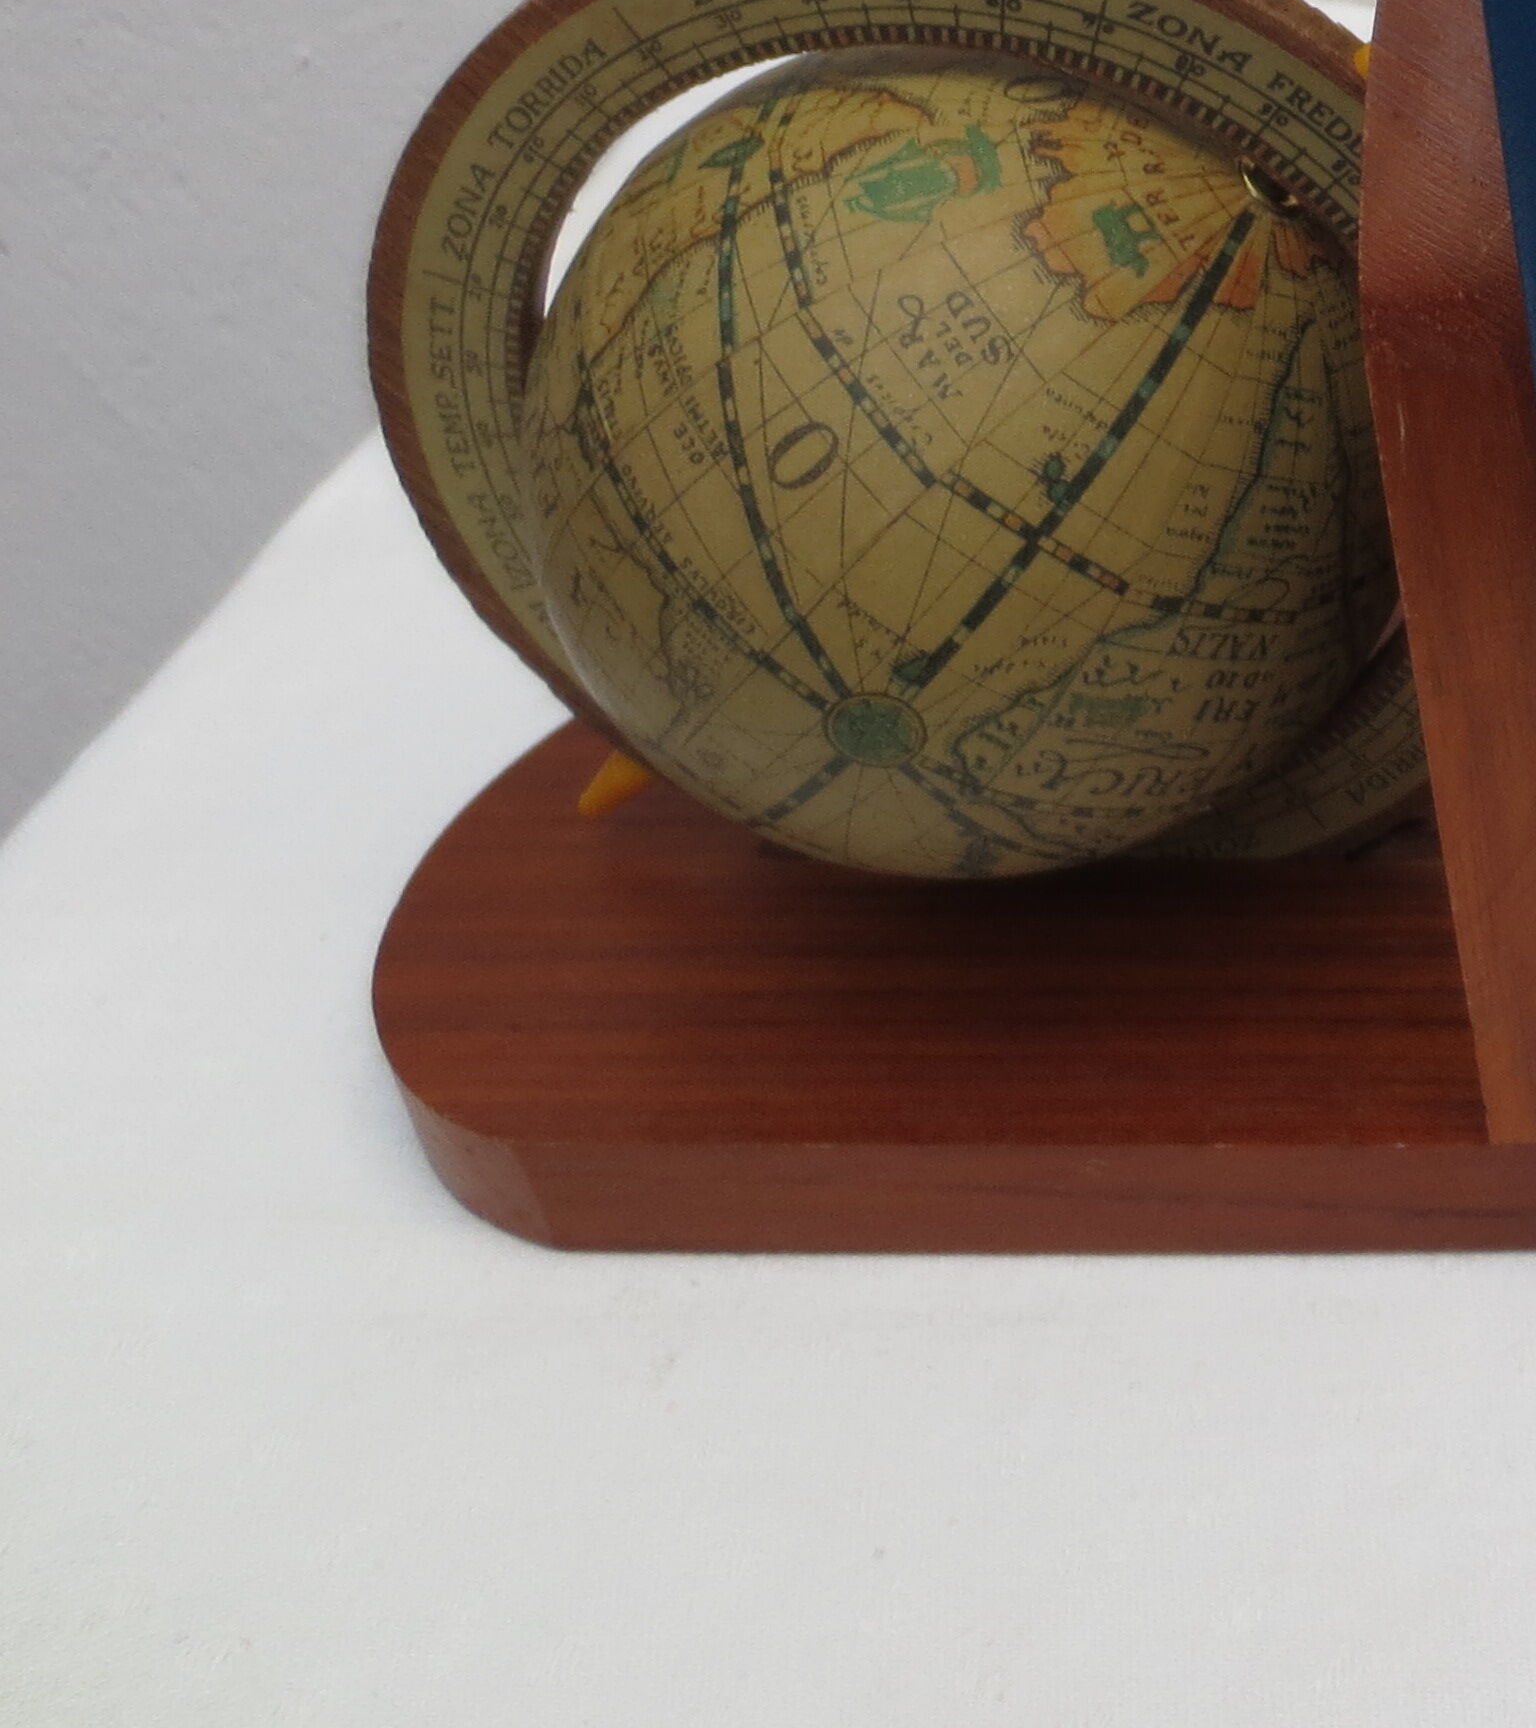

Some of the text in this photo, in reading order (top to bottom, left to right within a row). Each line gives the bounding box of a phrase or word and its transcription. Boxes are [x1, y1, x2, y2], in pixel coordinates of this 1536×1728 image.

[1126, 1, 1253, 71] ZONA
[440, 37, 607, 263] ZONA TORRIDA
[944, 291, 1014, 365] SUD
